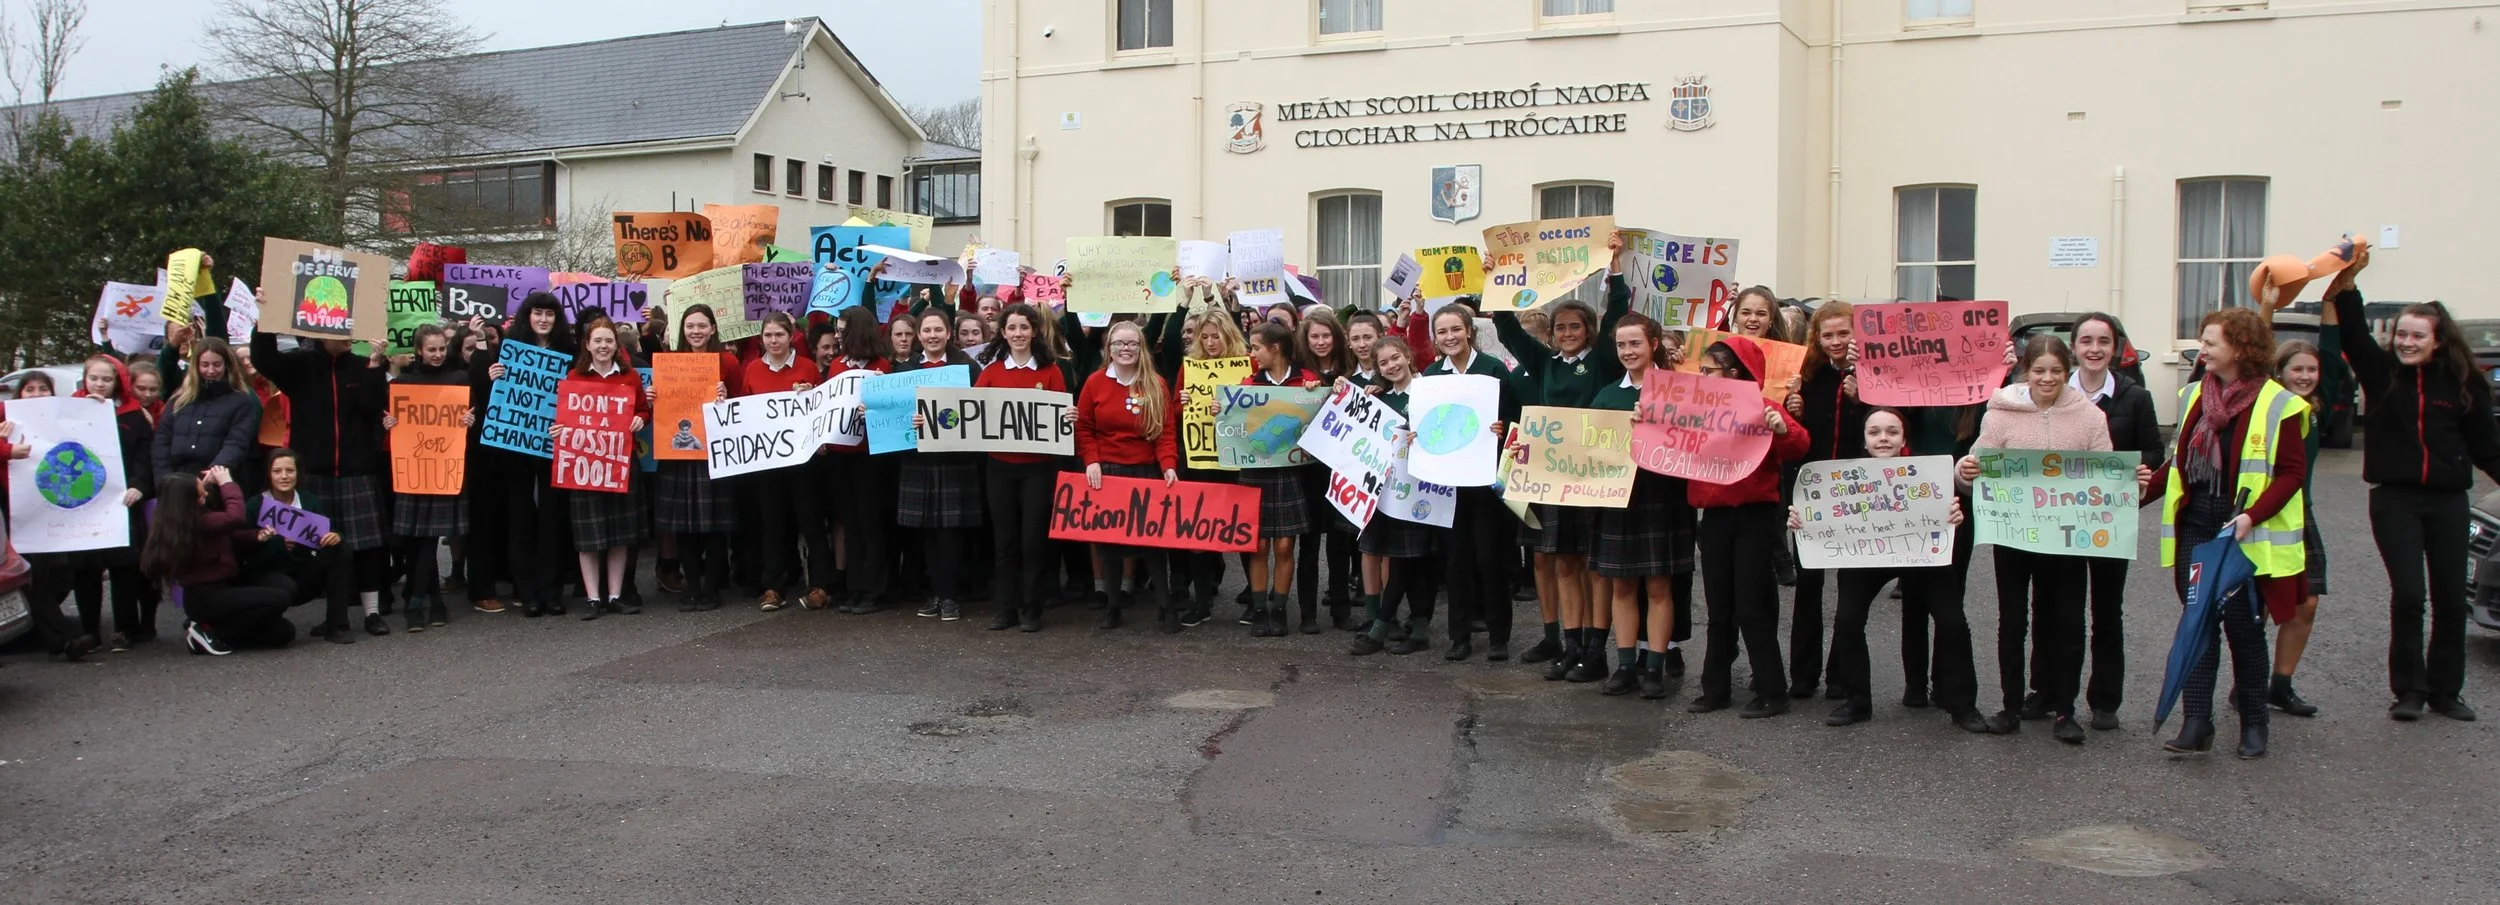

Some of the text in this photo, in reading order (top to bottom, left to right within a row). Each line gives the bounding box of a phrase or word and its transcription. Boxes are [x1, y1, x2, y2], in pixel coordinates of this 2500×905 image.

[1277, 82, 1650, 121] MEÁN SCOIL CHROÍ NAOFA
[1294, 112, 1627, 148] CLOCHAR NA TRÓCAIRE
[685, 219, 711, 242] No
[1496, 226, 1591, 247] The oceans
[312, 247, 345, 266] WE
[662, 245, 678, 271] B
[814, 233, 869, 264] Act
[1498, 253, 1525, 266] are
[1619, 230, 1695, 263] THERE
[291, 260, 360, 279] DESERVE
[450, 266, 523, 281] CLIMATE
[743, 264, 770, 279] THE
[1057, 265, 1065, 276] 2
[1494, 266, 1527, 286] and
[745, 295, 802, 305] THEY HAD
[746, 282, 806, 294] THOUGHT
[1244, 279, 1276, 295] IKEA
[449, 287, 503, 321] Bro.
[550, 282, 629, 319] ARTH
[1629, 279, 1729, 329] LANET B
[296, 310, 355, 330] FUTURE
[1963, 308, 1999, 327] are
[500, 342, 570, 374] SYSTEM
[1864, 335, 1949, 364] melting
[1185, 359, 1250, 370] THIS IS NOT
[1911, 355, 1935, 371] ARK
[890, 372, 935, 389] CLIMATE
[1651, 373, 1733, 407] We have
[1865, 367, 1989, 390] SAVE US THIS
[568, 392, 628, 415] DON'T
[713, 375, 865, 427] WE STAND WIT
[1343, 387, 1373, 424] WAS
[1368, 408, 1381, 432] A
[579, 414, 609, 427] BE A
[959, 399, 1067, 443] PLANET
[1321, 410, 1353, 442] BUT
[482, 424, 554, 452] CHANGE
[560, 427, 630, 464] FOSSIL
[710, 429, 794, 469] FRIDAYS
[1664, 426, 1709, 454] STOP
[394, 456, 465, 492] FUTURE
[557, 450, 627, 489] FOOL!
[1800, 468, 1822, 486] Ce
[1883, 464, 1917, 487] pas
[1509, 468, 1551, 501] Stop
[1980, 481, 2024, 504] the
[261, 505, 305, 531] ACT
[1050, 482, 1254, 547] Action Not Words
[1818, 529, 1837, 538] not
[1845, 524, 1867, 536] the
[1872, 521, 1896, 534] heat
[1921, 513, 1942, 528] the
[1976, 505, 2113, 531] thought they HAD
[1987, 520, 2040, 544] TIME
